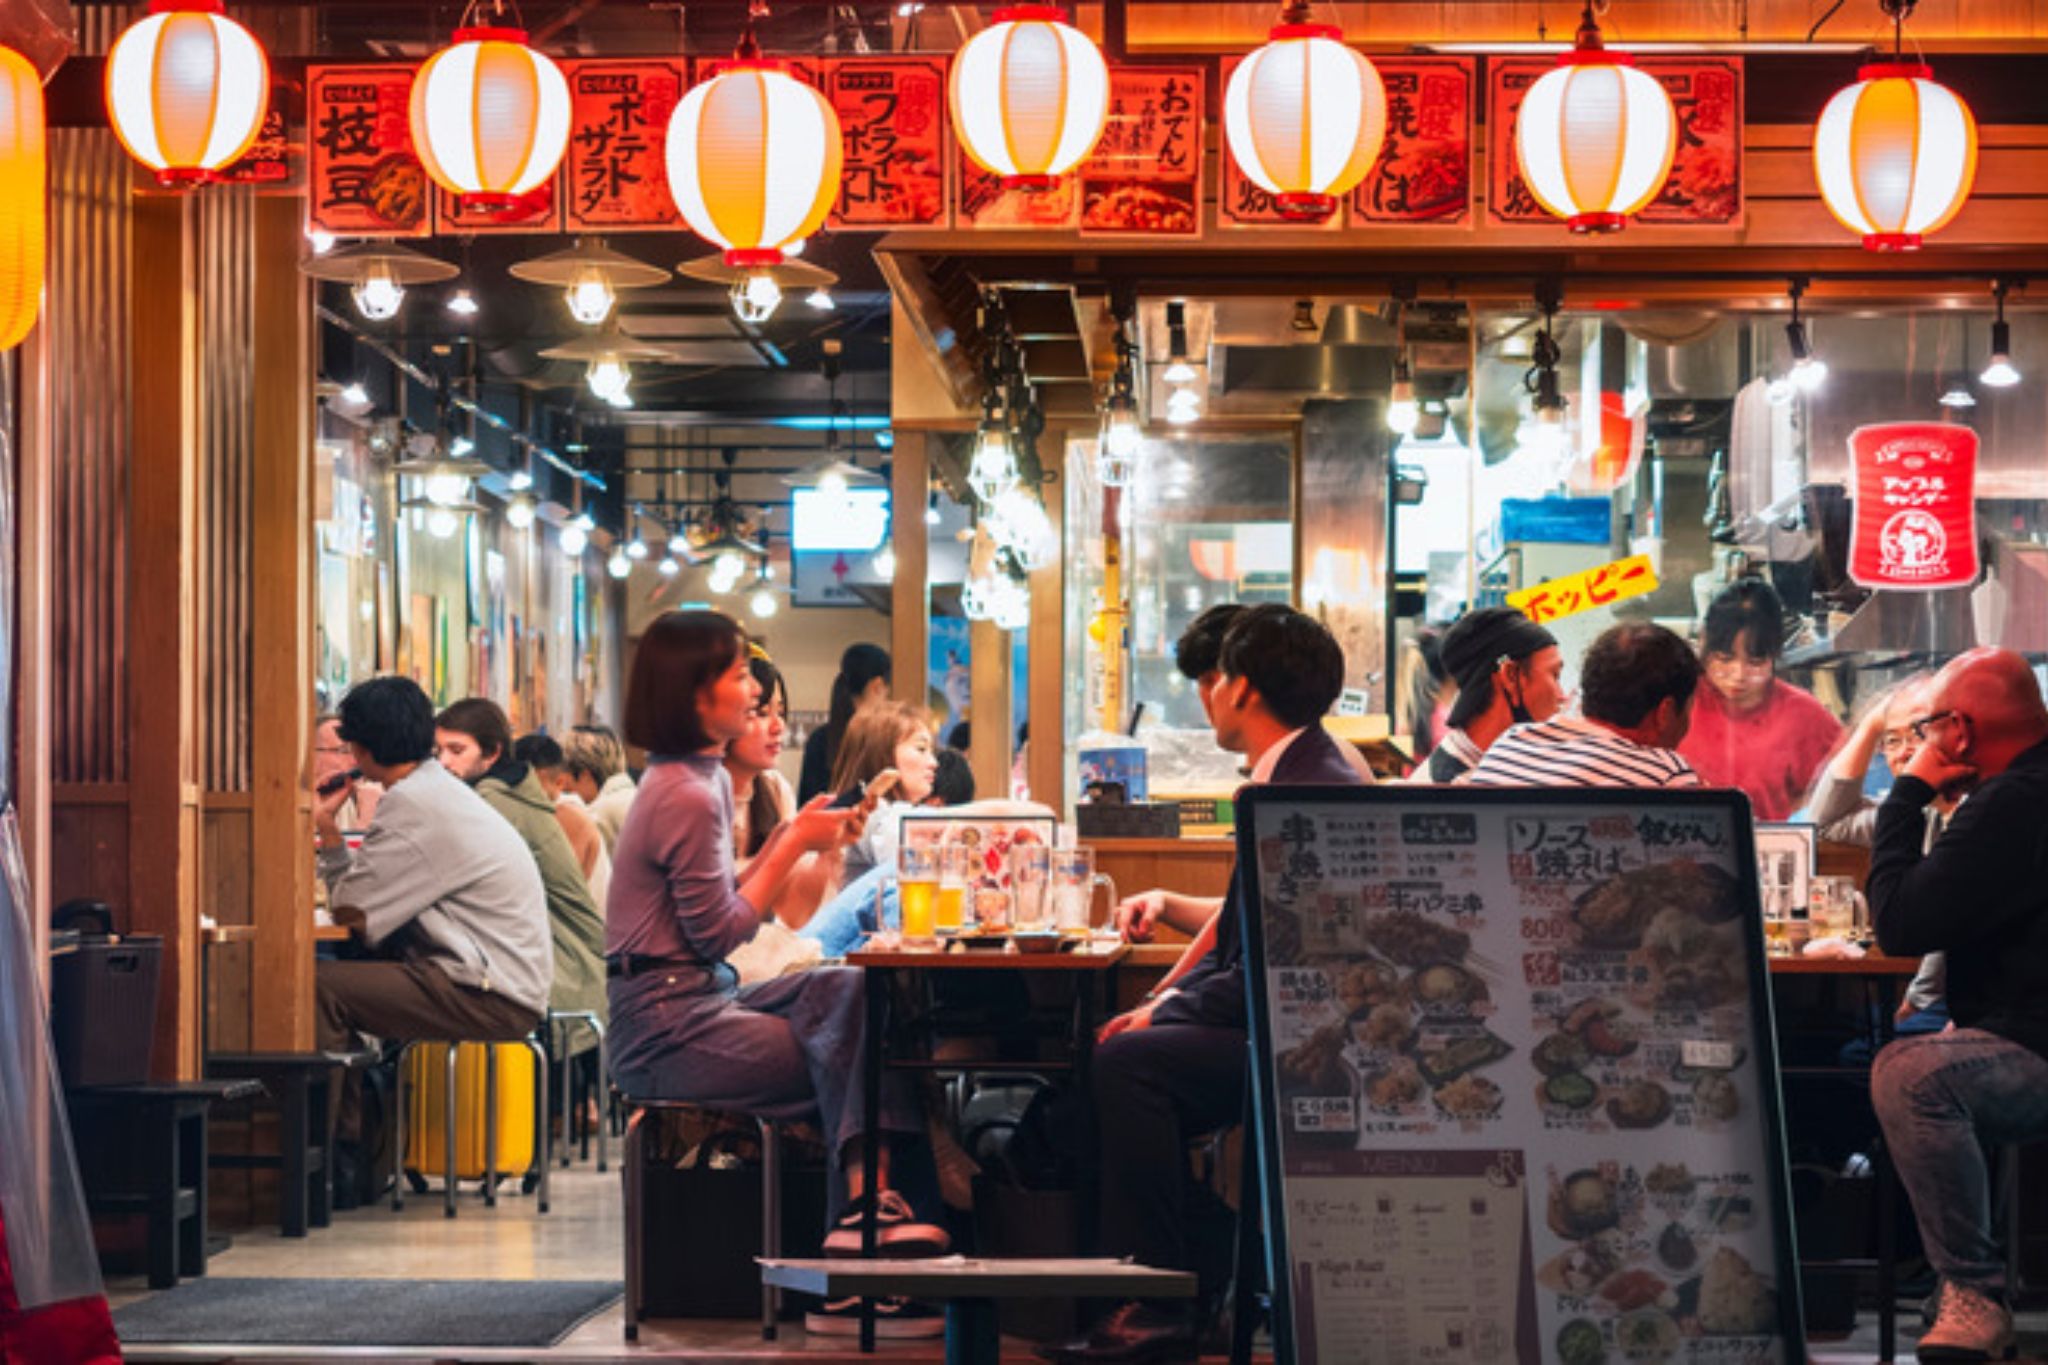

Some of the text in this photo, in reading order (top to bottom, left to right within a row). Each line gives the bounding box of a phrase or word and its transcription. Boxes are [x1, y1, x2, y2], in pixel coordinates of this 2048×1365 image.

[317, 105, 380, 209] 枝豆
[606, 94, 648, 198] ポテト
[862, 93, 899, 204] フライド
[1157, 77, 1192, 167] おでん
[574, 124, 615, 213] サラダ
[1526, 563, 1646, 624] ホッピー
[1515, 821, 1592, 852] ソース
[1361, 1154, 1438, 1173] MENU
